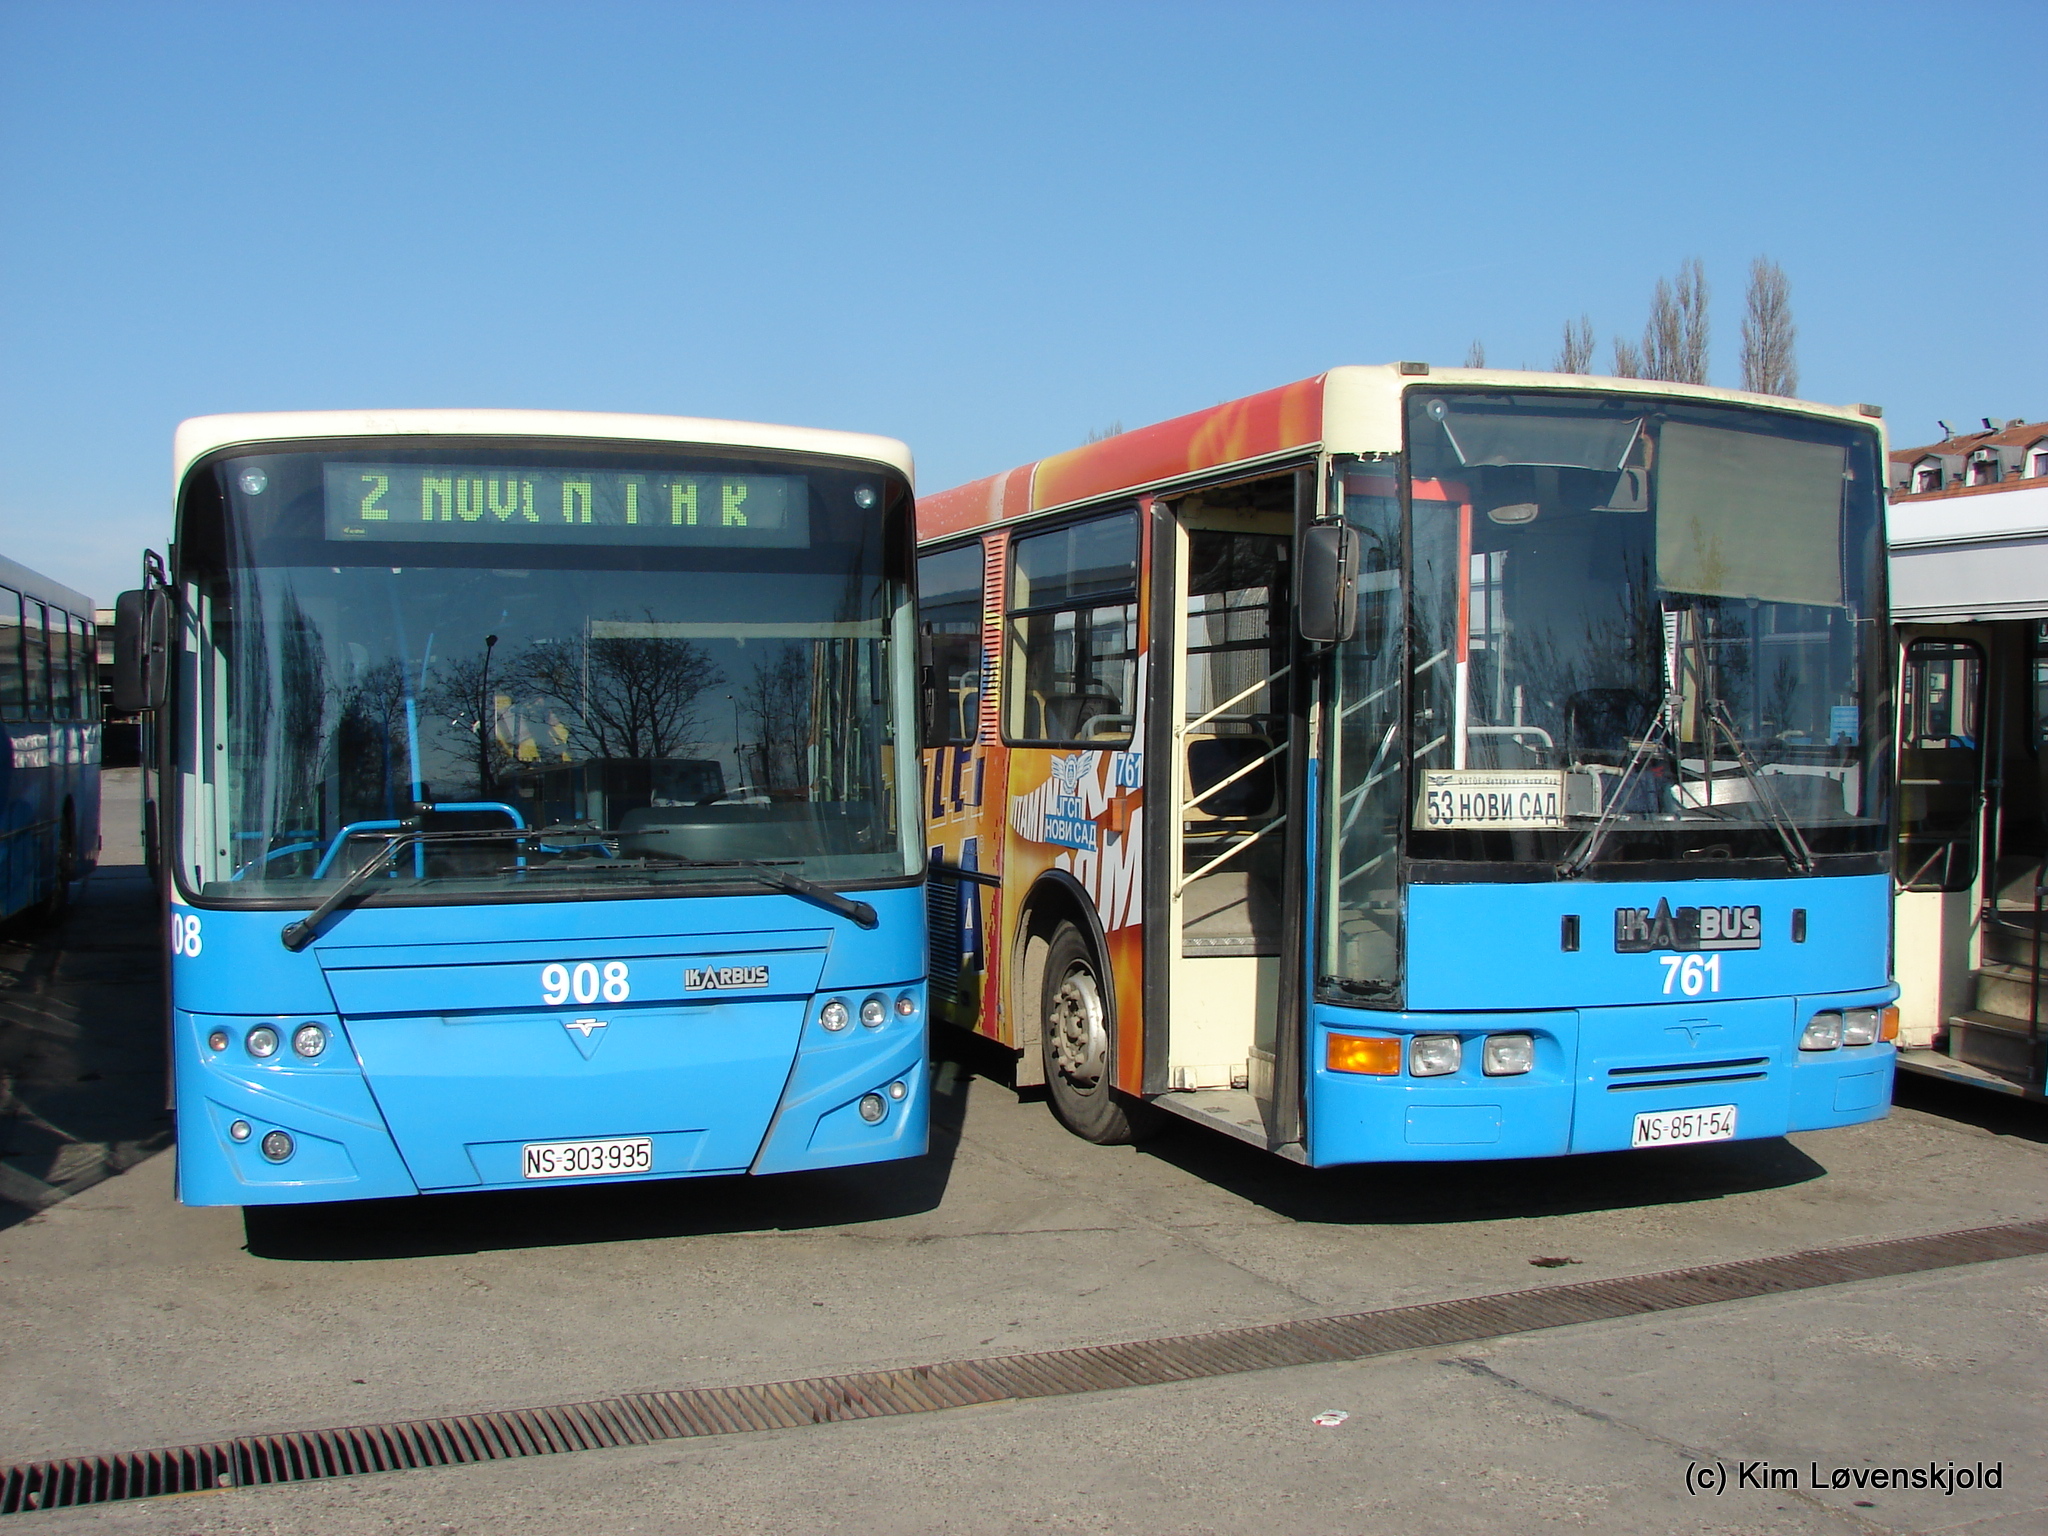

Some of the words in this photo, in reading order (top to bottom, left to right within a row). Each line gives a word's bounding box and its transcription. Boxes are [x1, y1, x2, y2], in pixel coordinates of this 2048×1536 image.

[1117, 753, 1142, 788] 761
[1428, 790, 1454, 825] 53
[1460, 792, 1513, 822] НОВИ
[1519, 792, 1559, 825] САД
[1045, 817, 1072, 843] НОВИ
[1073, 821, 1097, 851] САД
[1616, 897, 1761, 953] IKARBUS
[541, 961, 631, 1006] 908
[685, 965, 769, 991] IKARBUS
[1659, 953, 1720, 996] 761
